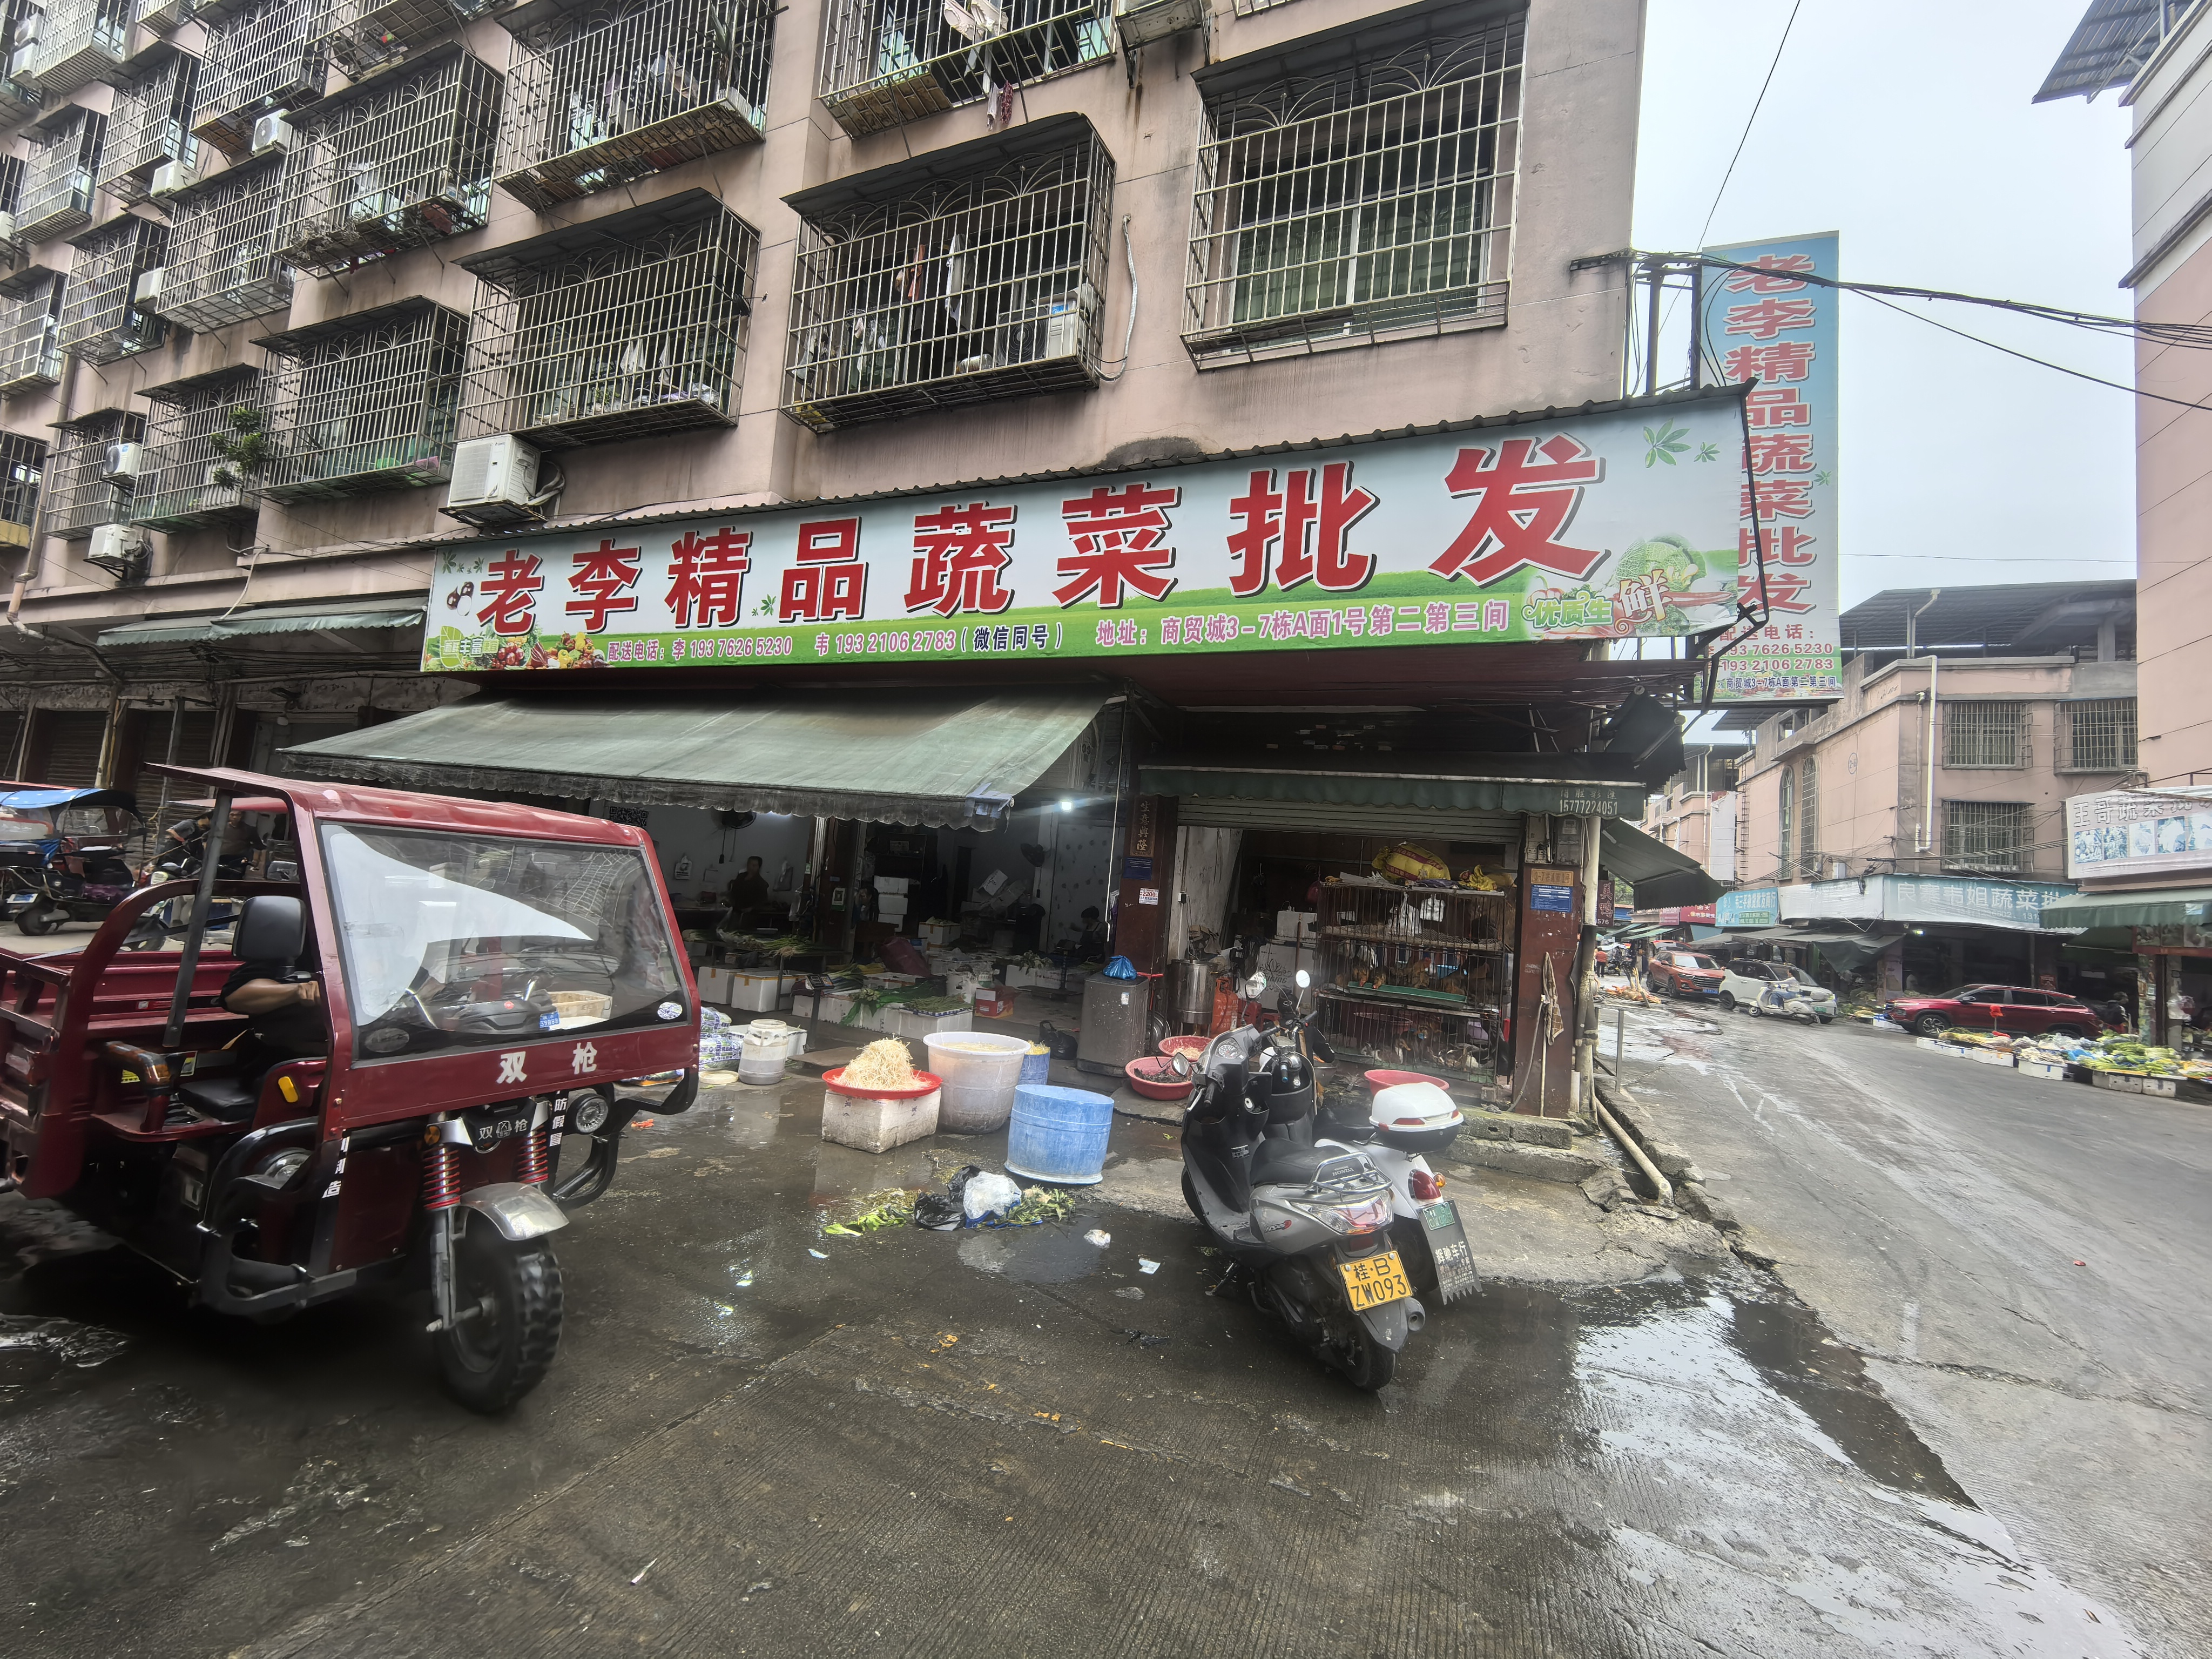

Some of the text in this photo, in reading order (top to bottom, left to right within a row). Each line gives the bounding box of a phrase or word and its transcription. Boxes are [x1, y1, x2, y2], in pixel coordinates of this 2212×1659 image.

[1723, 254, 1817, 615] 老李精品蔬菜批发
[477, 433, 1611, 636] 老李精品蔬菜批发
[673, 638, 685, 660] 李
[1560, 800, 1618, 815] 15777224051
[1332, 1168, 1354, 1176] HONDA
[1350, 1274, 1407, 1307] ZW093
